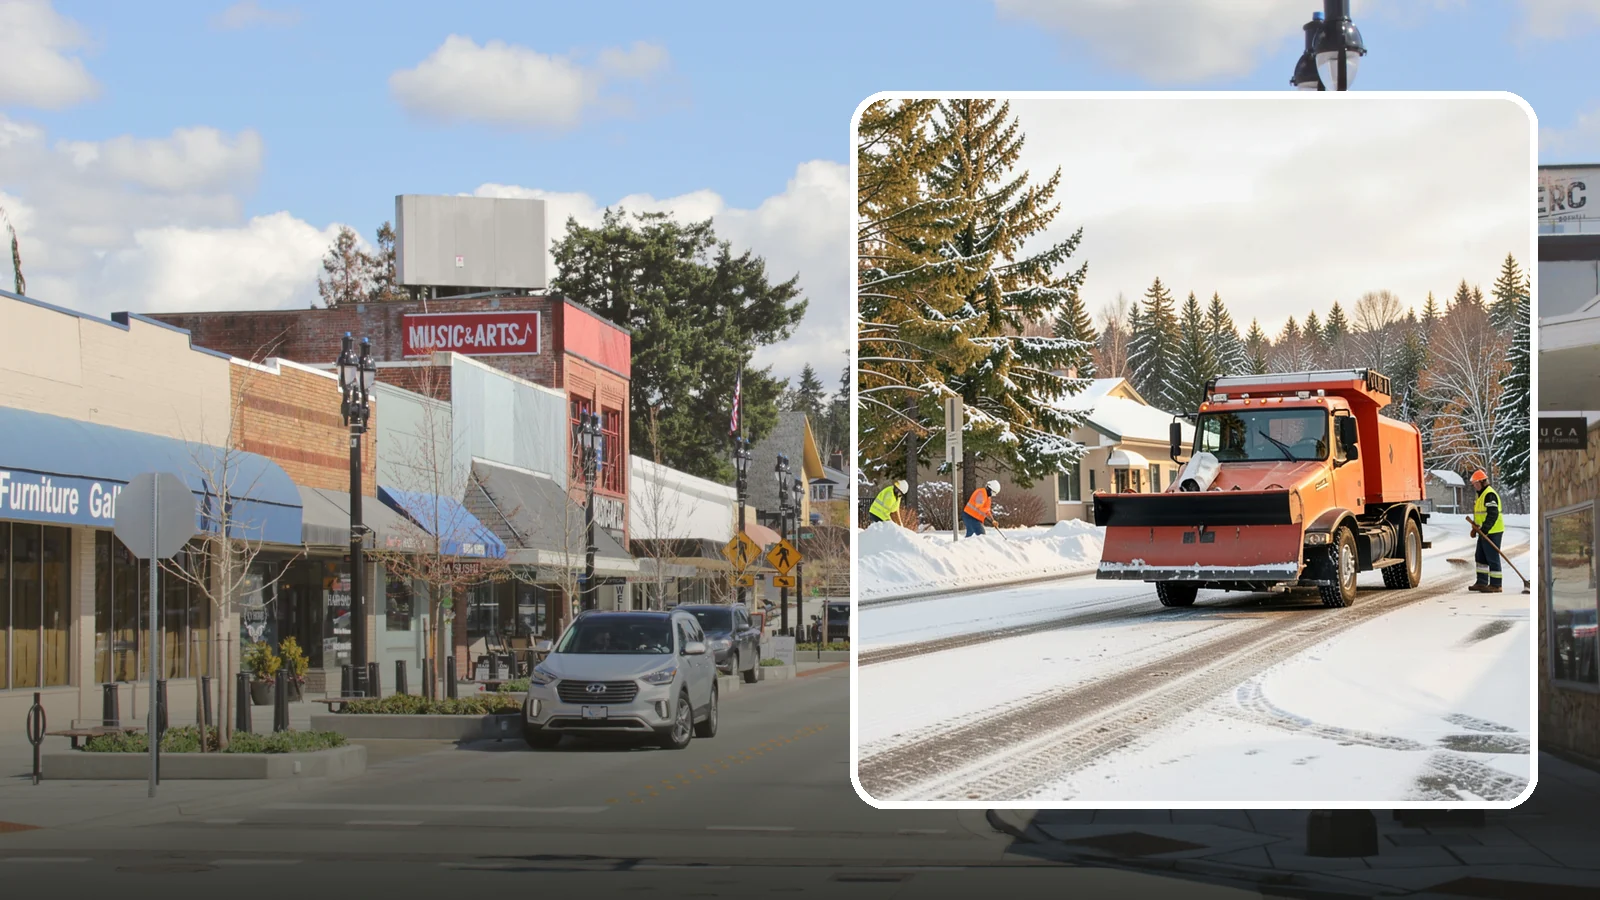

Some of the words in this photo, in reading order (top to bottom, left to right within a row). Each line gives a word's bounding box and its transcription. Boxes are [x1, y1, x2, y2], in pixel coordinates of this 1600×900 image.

[1552, 436, 1579, 444] Framing
[0, 471, 79, 516] Furniture
[89, 482, 122, 519] Gal
[453, 563, 479, 574] SUSHI
